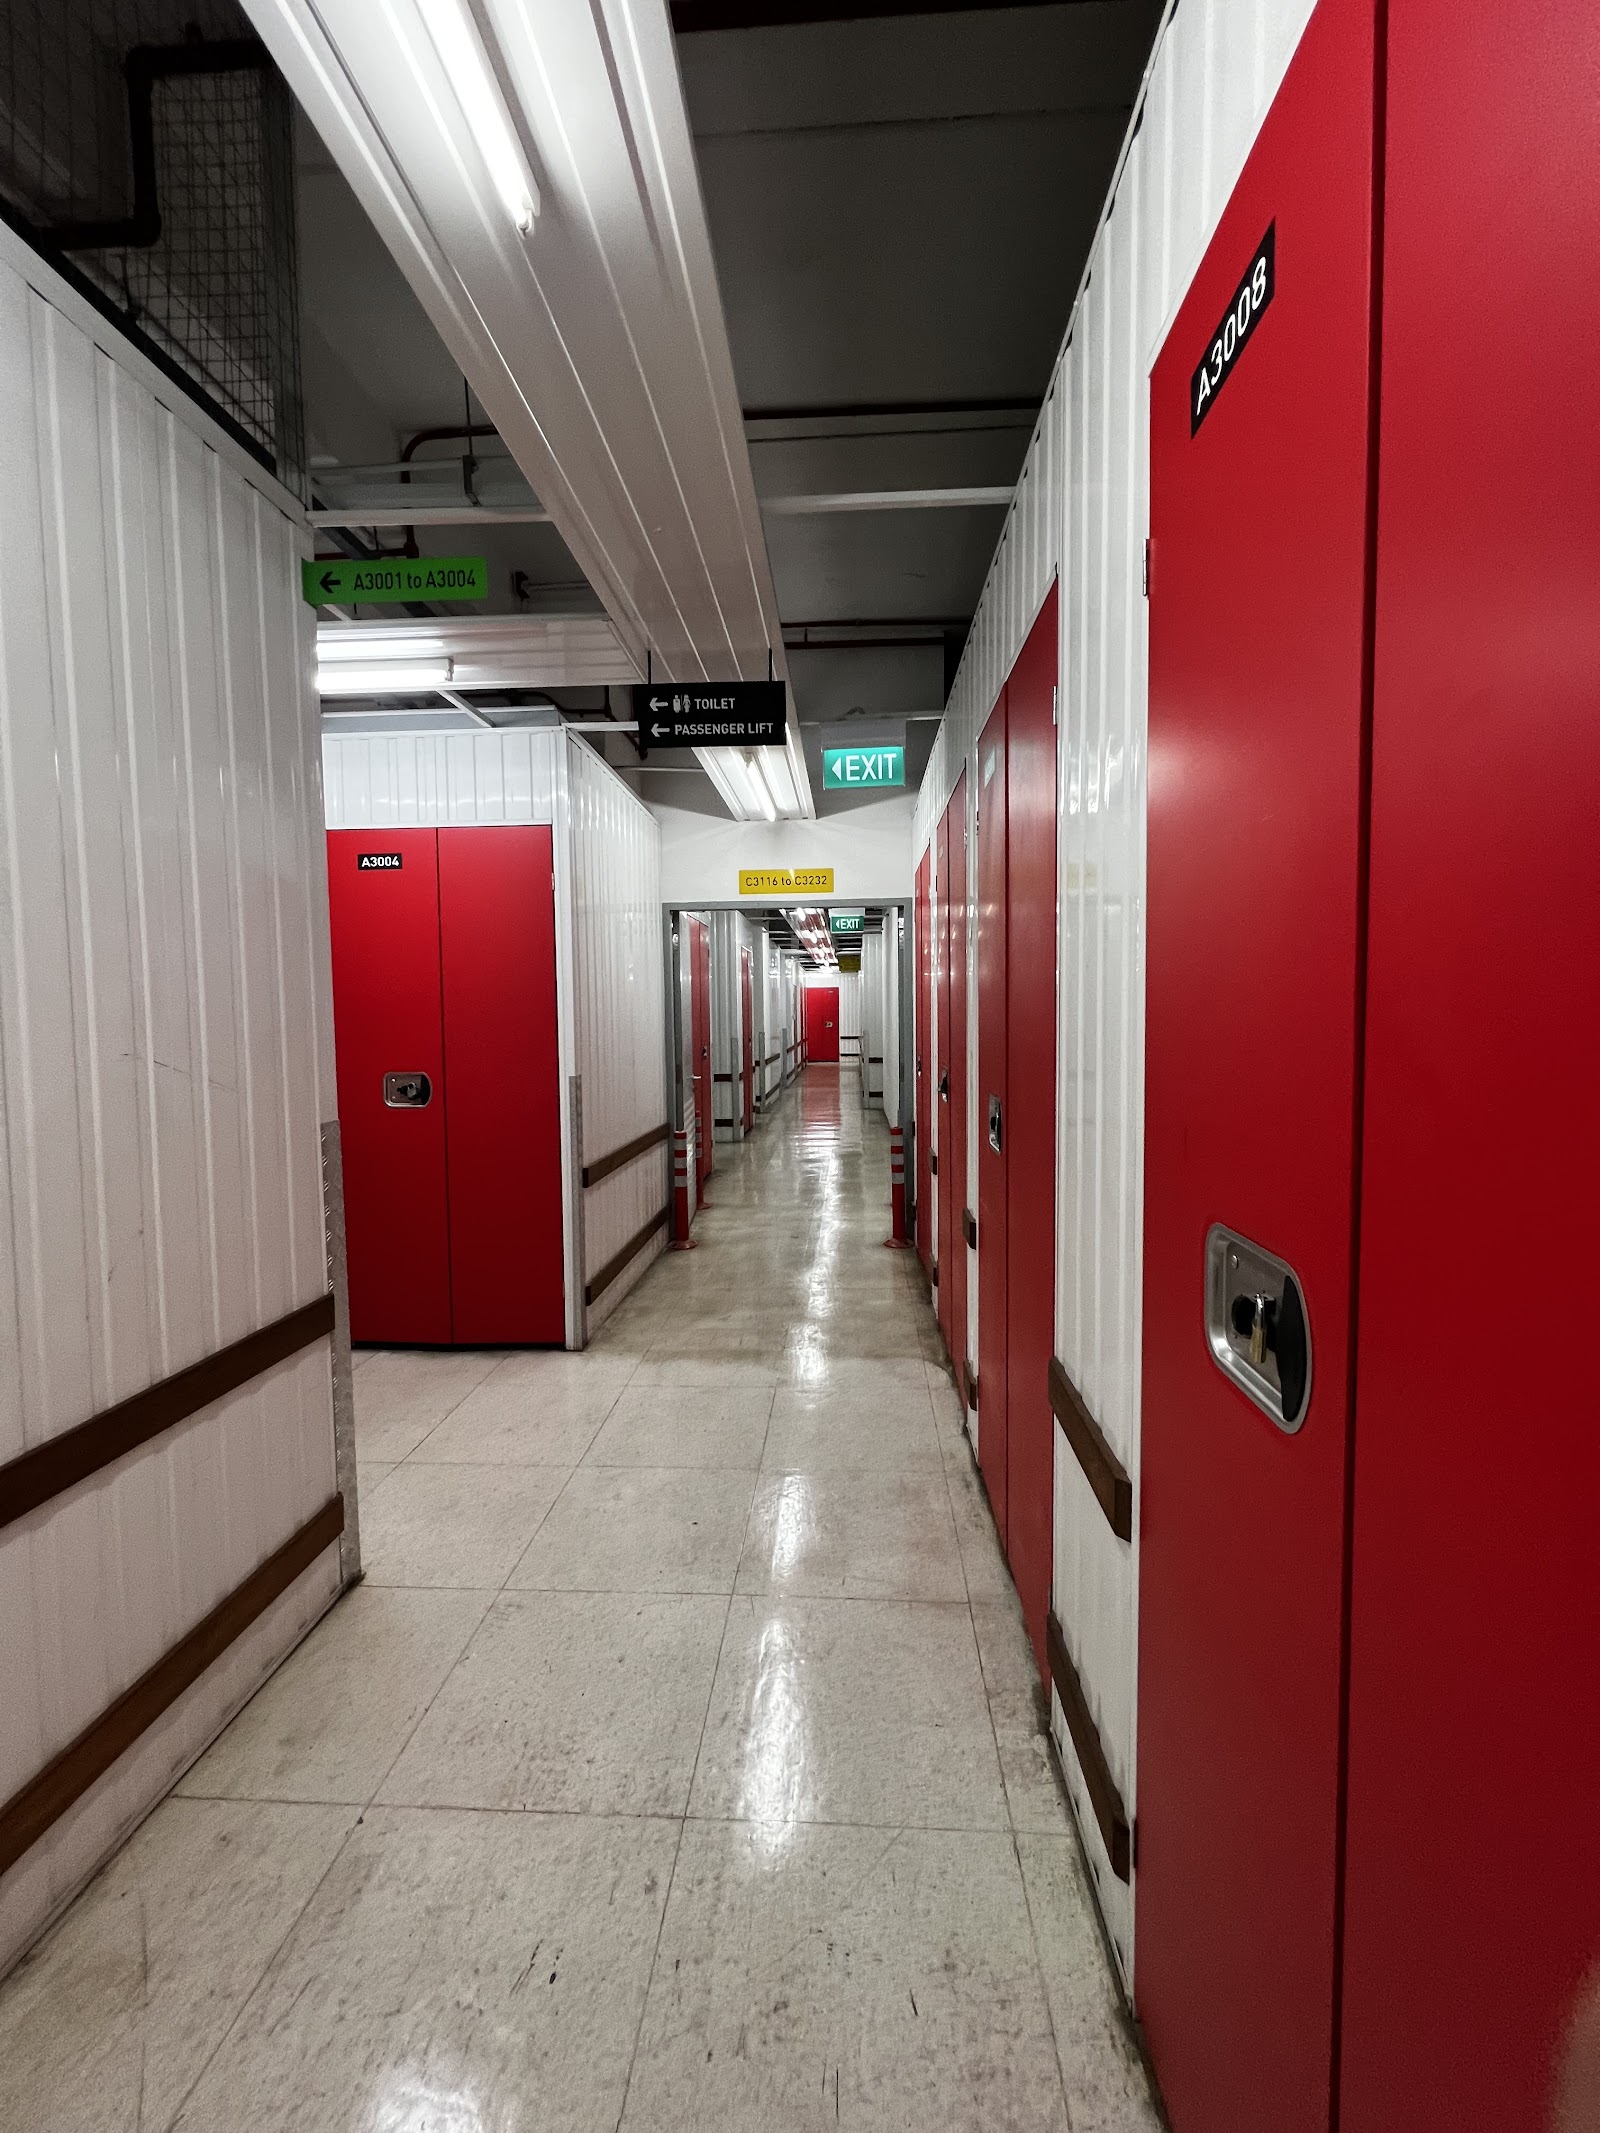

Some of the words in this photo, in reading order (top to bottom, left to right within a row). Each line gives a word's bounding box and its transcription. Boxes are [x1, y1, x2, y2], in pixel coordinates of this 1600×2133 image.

[1196, 256, 1267, 416] A3008
[353, 572, 402, 591] A3001
[407, 574, 422, 589] to
[425, 569, 476, 588] A3004
[694, 697, 736, 710] TOILET
[674, 722, 745, 736] PASSENGER
[747, 722, 774, 735] LIFT
[845, 753, 897, 782] EXIT
[361, 855, 400, 868] A3004
[745, 876, 778, 887] C3116
[781, 877, 792, 886] to
[794, 875, 828, 886] C3232
[840, 918, 860, 930] EXIT
